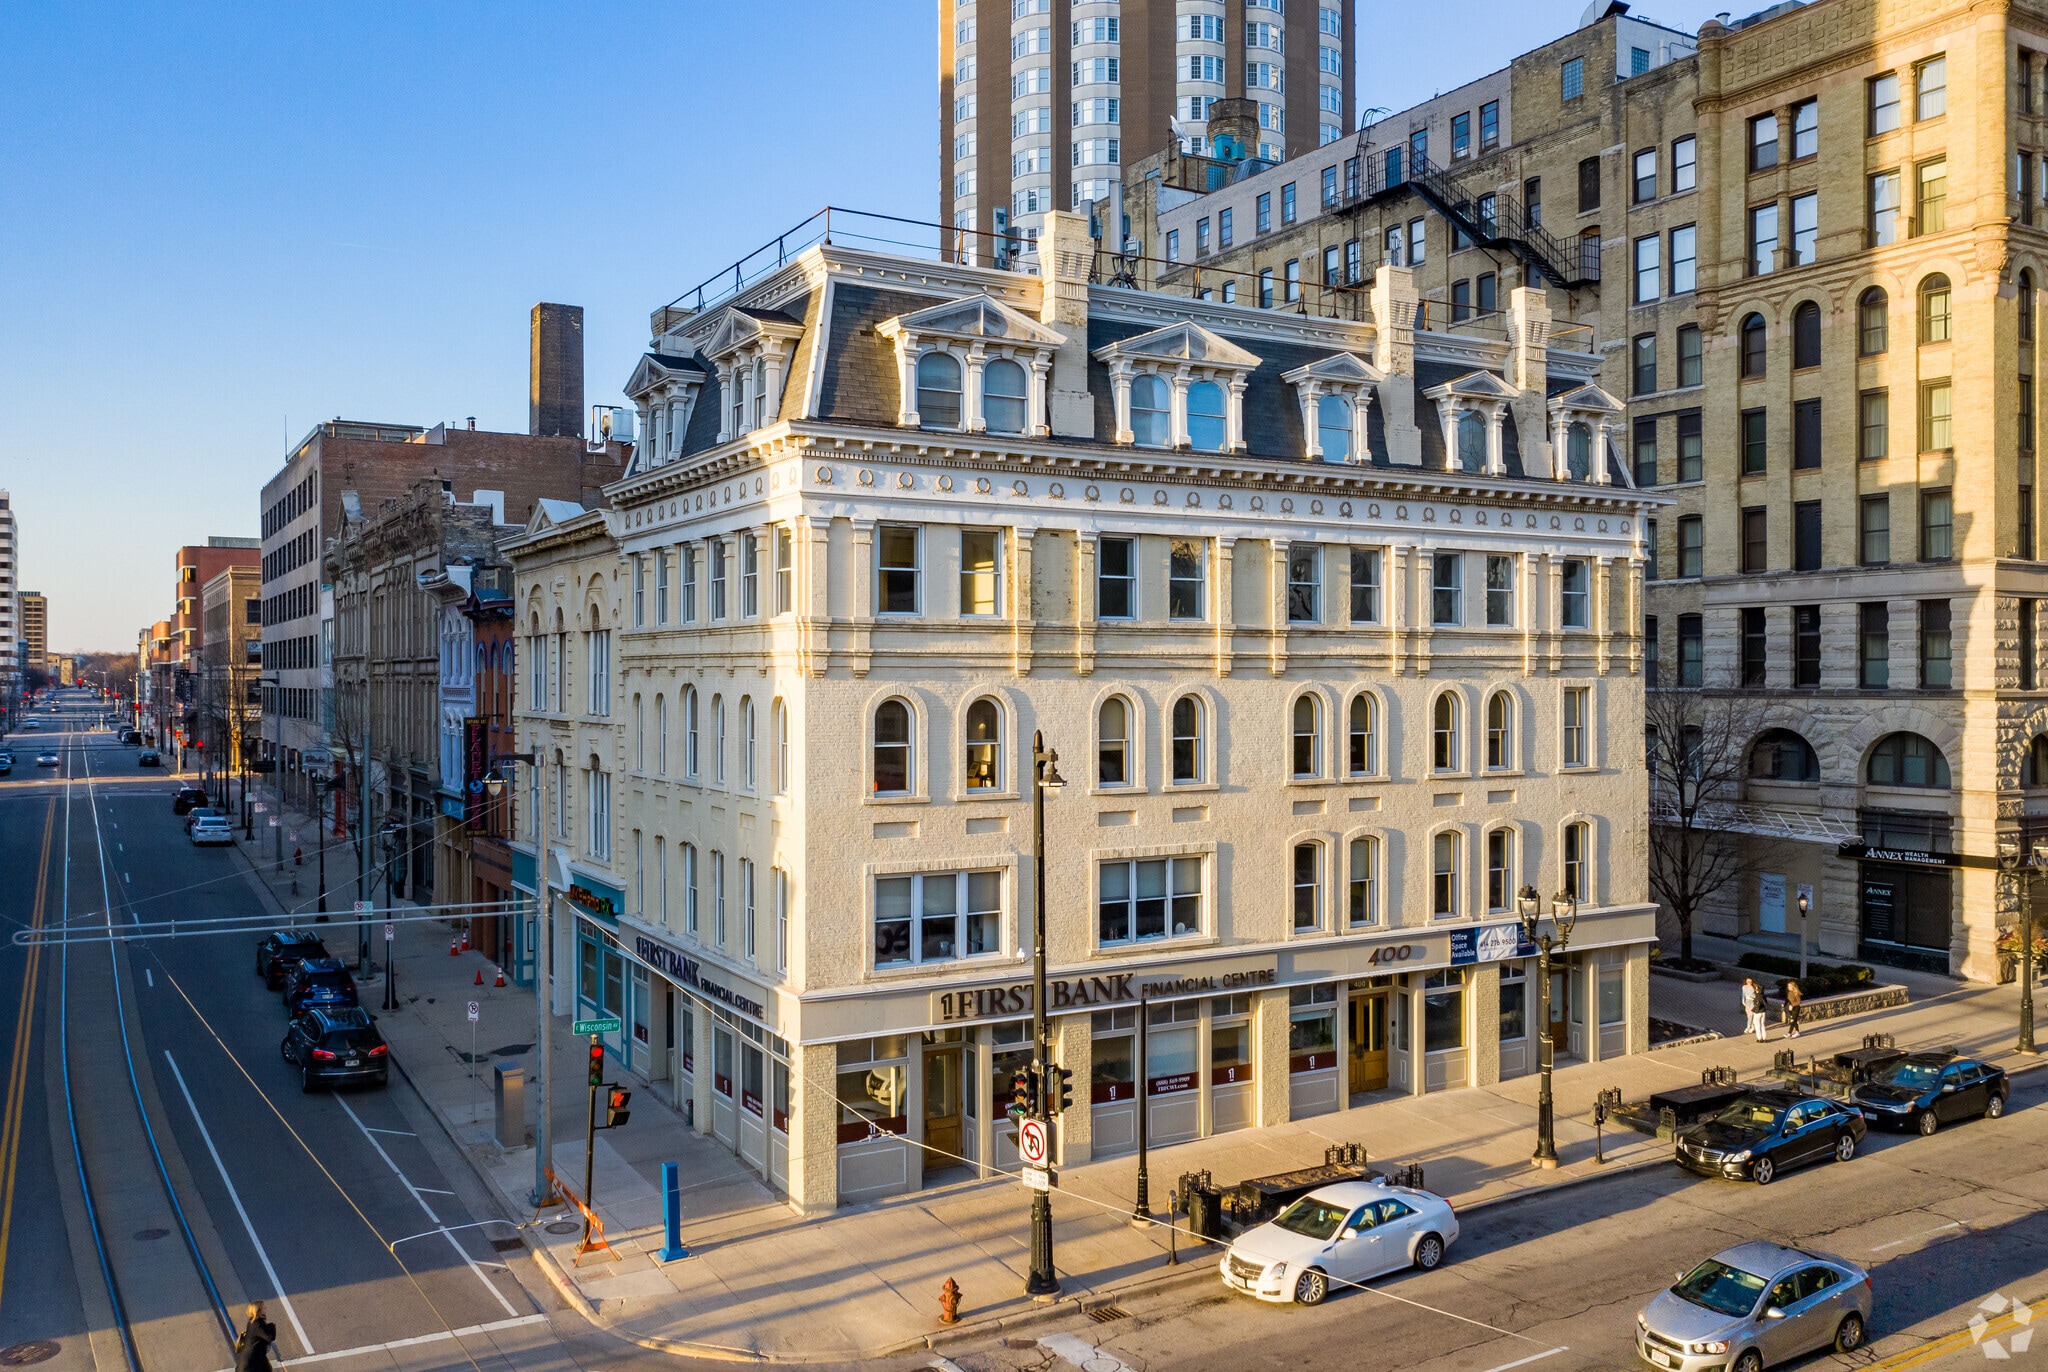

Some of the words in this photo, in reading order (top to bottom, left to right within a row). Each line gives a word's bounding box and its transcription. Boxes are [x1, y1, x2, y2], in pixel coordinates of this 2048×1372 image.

[1904, 856, 1946, 864] MANAGEMENT
[1451, 934, 1468, 942] Office
[1451, 943, 1468, 951] Space
[1367, 944, 1412, 966] 400
[1451, 949, 1476, 958] Available
[669, 951, 700, 988] BANK
[701, 977, 734, 1005] FINANCIAL
[735, 994, 764, 1020] CENTRE
[1051, 972, 1135, 1008] BANK
[1141, 976, 1218, 998] FINANCIAL
[1222, 968, 1275, 988] CENTRE
[1353, 980, 1366, 988] 400
[580, 1021, 612, 1032] Wisconsin
